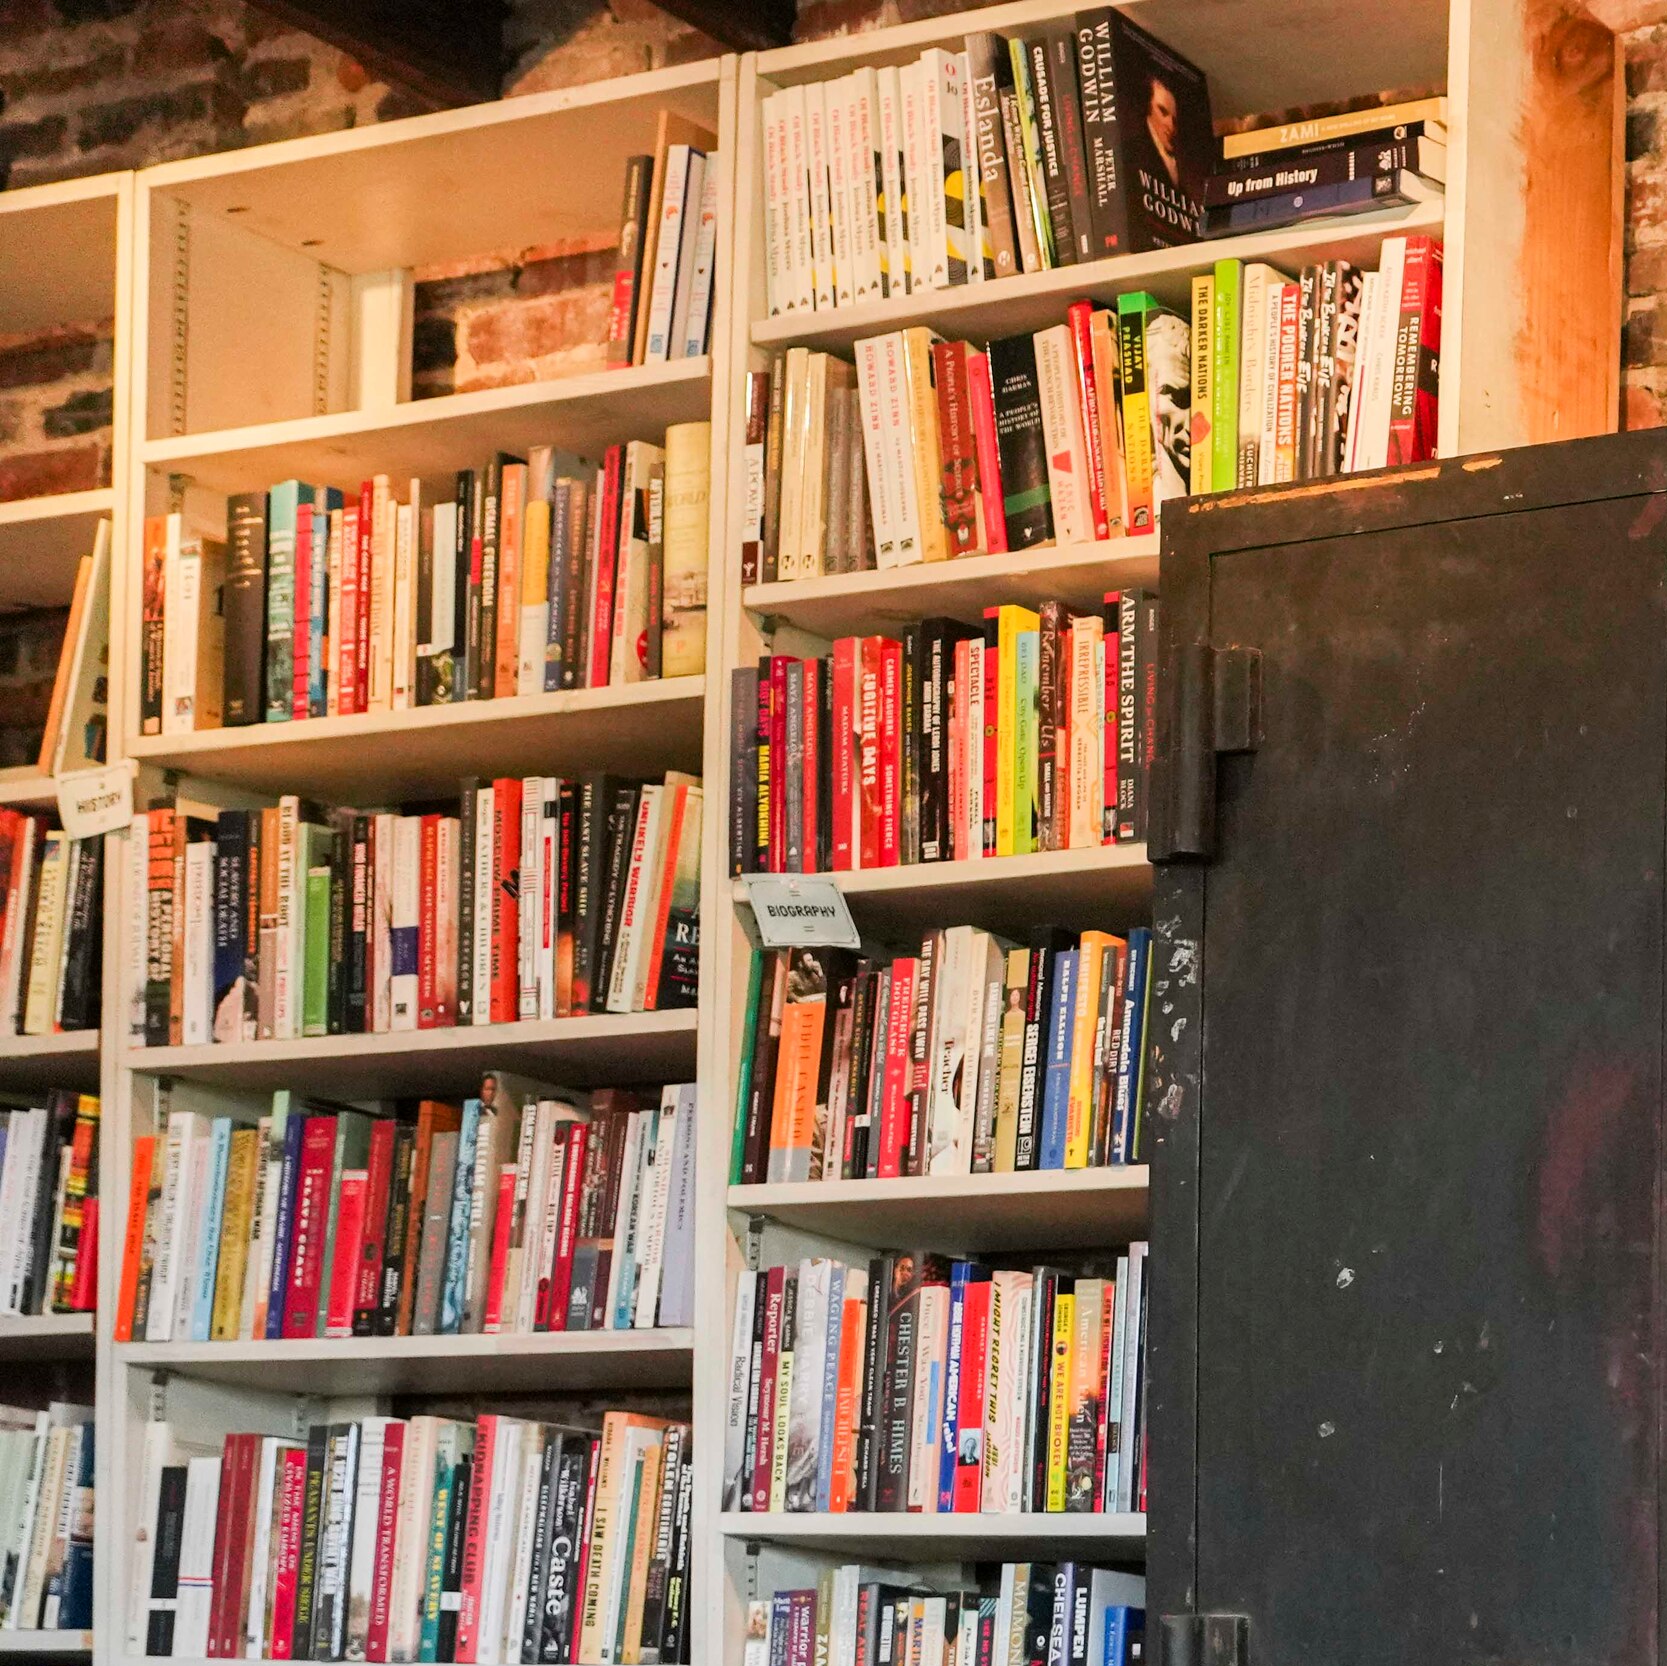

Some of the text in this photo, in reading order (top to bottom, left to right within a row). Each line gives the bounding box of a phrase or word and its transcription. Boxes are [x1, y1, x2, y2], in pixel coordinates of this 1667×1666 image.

[1033, 46, 1058, 177] CRUSADE FOR JUSTICE
[1080, 28, 1101, 122] GODWIN
[1095, 22, 1117, 122] WILLIAM
[976, 75, 1004, 183] Eslanda
[1281, 122, 1319, 143] ZAMI
[1228, 168, 1318, 196] Up from History
[1198, 285, 1208, 399] THE DARKER NATIONS
[1278, 295, 1296, 445] THE POORER NATIONS
[1392, 326, 1408, 406] TOMORROW
[1402, 317, 1419, 415] REMEMBERING
[970, 646, 980, 706] SPECTACLE
[1120, 645, 1136, 691] THE
[863, 672, 877, 786] FUGITIVE DAYS
[1120, 694, 1135, 763] SPIRIT
[767, 904, 836, 918] BIOGRAPHY
[1115, 999, 1136, 1111] Annandale Blues
[767, 1292, 781, 1354] Reporter
[774, 1361, 790, 1481] MY SOUL LOOKS BACK
[890, 1312, 912, 1475] CHESTER B. HIMES
[546, 1535, 572, 1616] Caste
[1050, 1573, 1066, 1663] CHELSEA
[1072, 1587, 1087, 1659] LUMPEN
